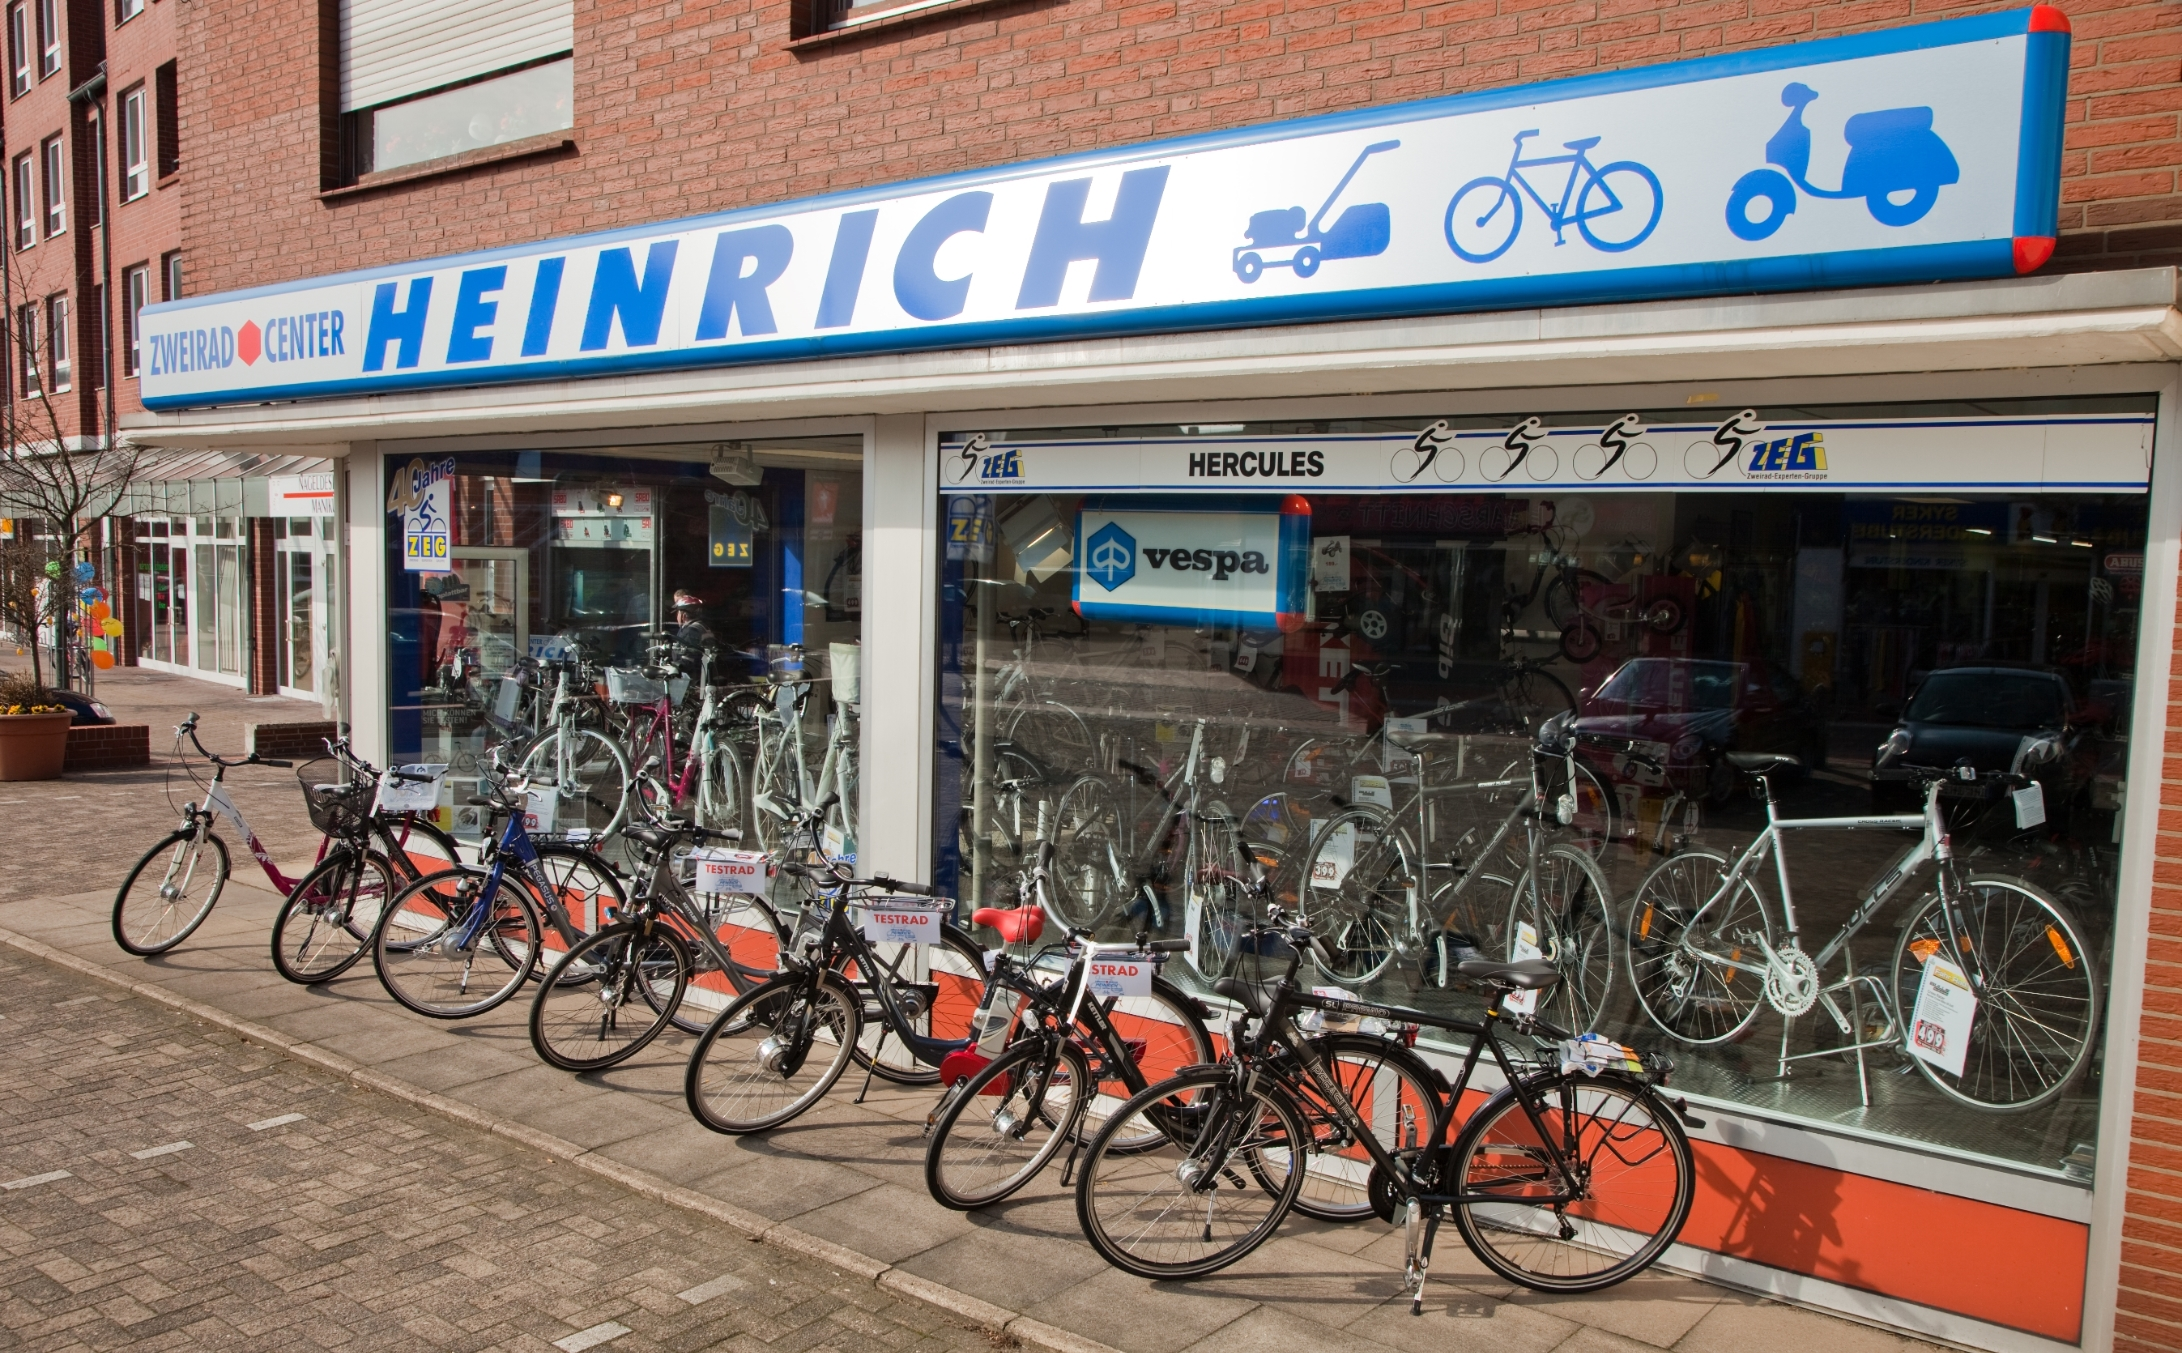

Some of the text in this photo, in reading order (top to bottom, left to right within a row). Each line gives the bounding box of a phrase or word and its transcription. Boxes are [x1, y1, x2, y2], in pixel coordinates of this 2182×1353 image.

[363, 165, 1170, 373] HEINRICH
[150, 310, 345, 375] ZWEIRAD CENTER
[981, 449, 1026, 478] ZEG
[1188, 450, 1325, 478] HERCULES
[1748, 431, 1828, 471] ZEG
[387, 457, 426, 518] 40
[413, 456, 456, 493] Jahre
[1746, 472, 1828, 481] Zweirad-Experten-Gruppe
[408, 536, 446, 557] ZEG
[1142, 548, 1269, 581] vespa
[705, 863, 755, 875] TESTRAD
[530, 863, 555, 906] PEGASUS
[873, 913, 929, 925] TESTRAD
[1088, 964, 1139, 977] STRAD
[1086, 1001, 1108, 1031] KETTLER
[1918, 1025, 1945, 1048] 499
